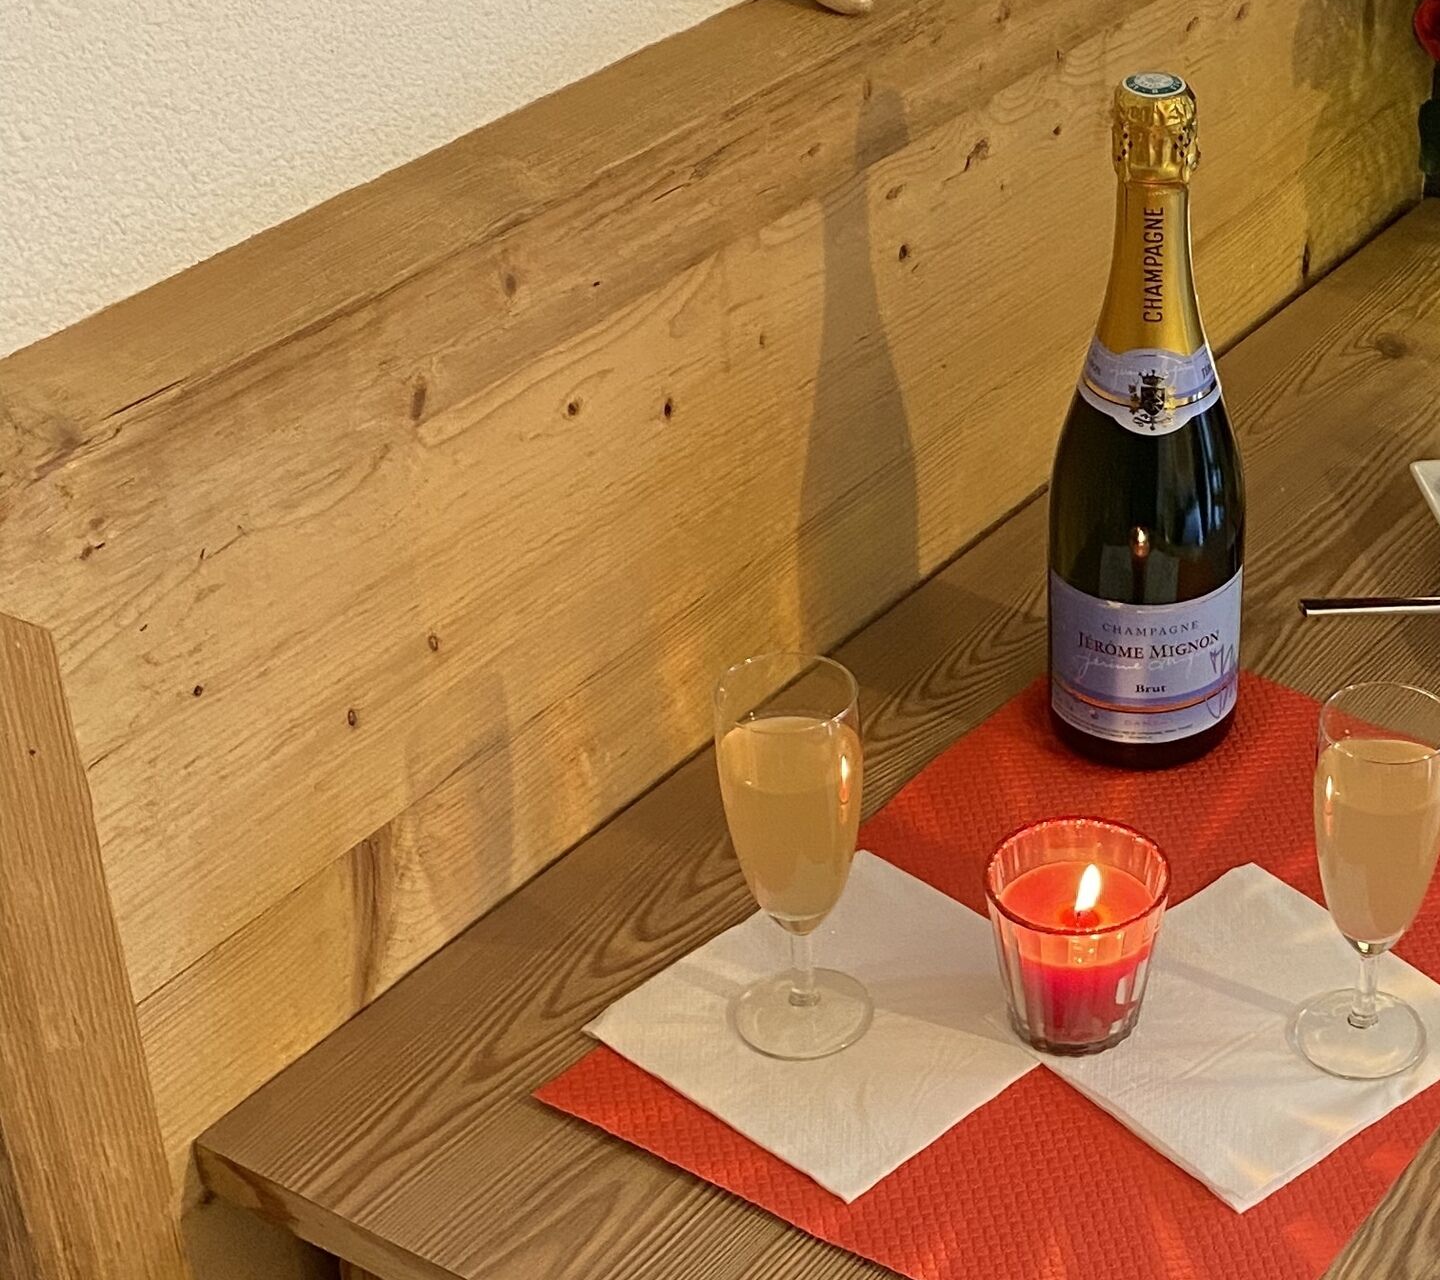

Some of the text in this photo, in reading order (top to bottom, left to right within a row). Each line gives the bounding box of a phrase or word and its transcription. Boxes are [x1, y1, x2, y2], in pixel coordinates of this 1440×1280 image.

[1143, 207, 1165, 324] CHAMPAGNE
[1101, 620, 1200, 638] CHAMPAGNE
[1149, 629, 1221, 660] MIGNON
[1135, 684, 1167, 693] Brut
